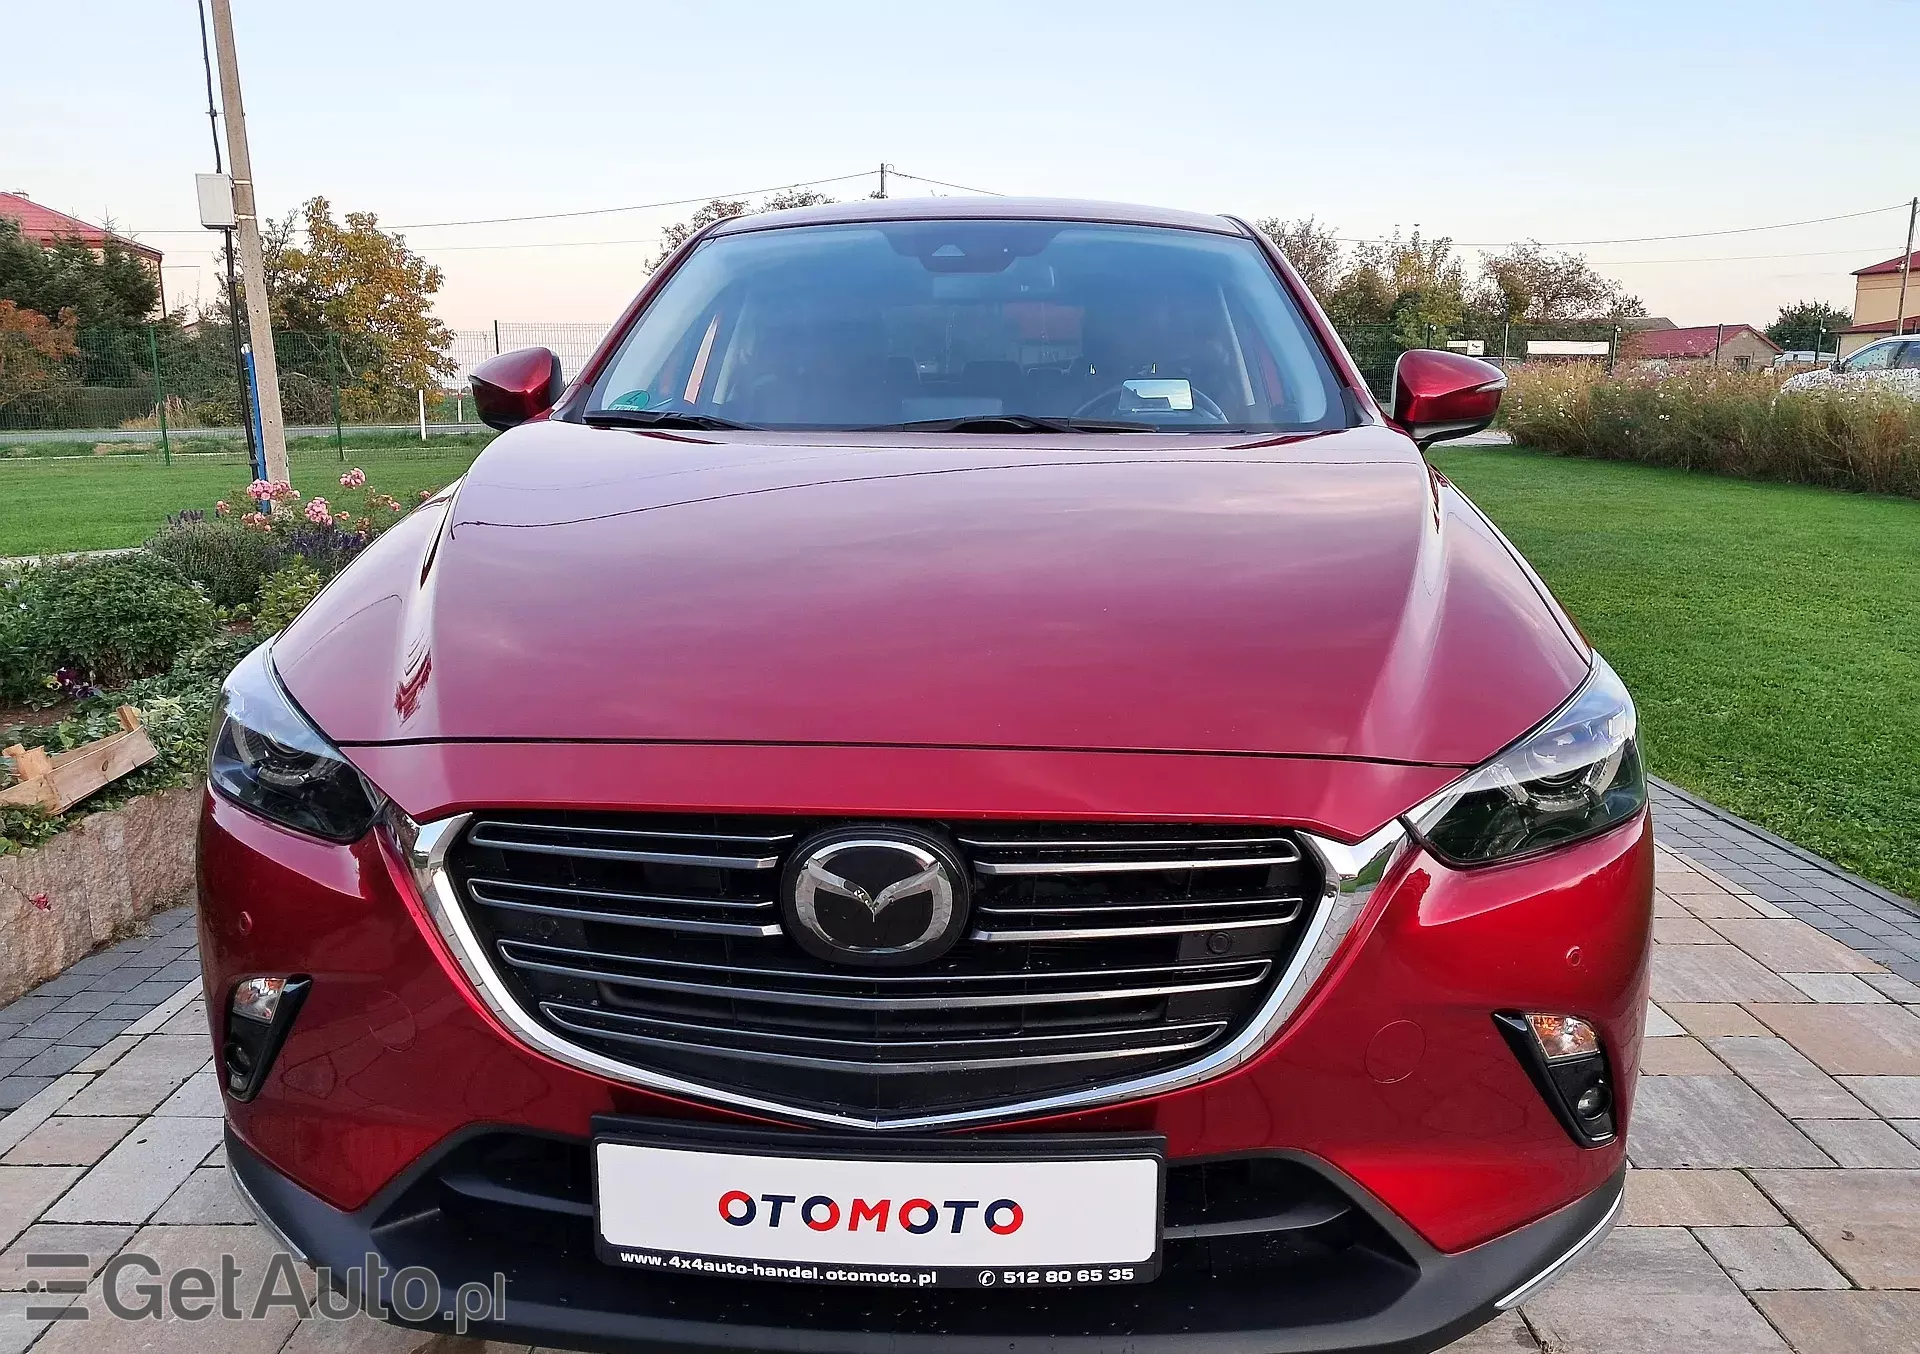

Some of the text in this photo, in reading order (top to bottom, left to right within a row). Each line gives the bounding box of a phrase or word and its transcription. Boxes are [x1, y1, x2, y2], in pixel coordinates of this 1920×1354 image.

[717, 1189, 1025, 1236] OTOMOTO
[620, 1252, 937, 1286] www.4x4auto-handel.otomoto.pl
[1003, 1268, 1134, 1284] 512 80 65 35
